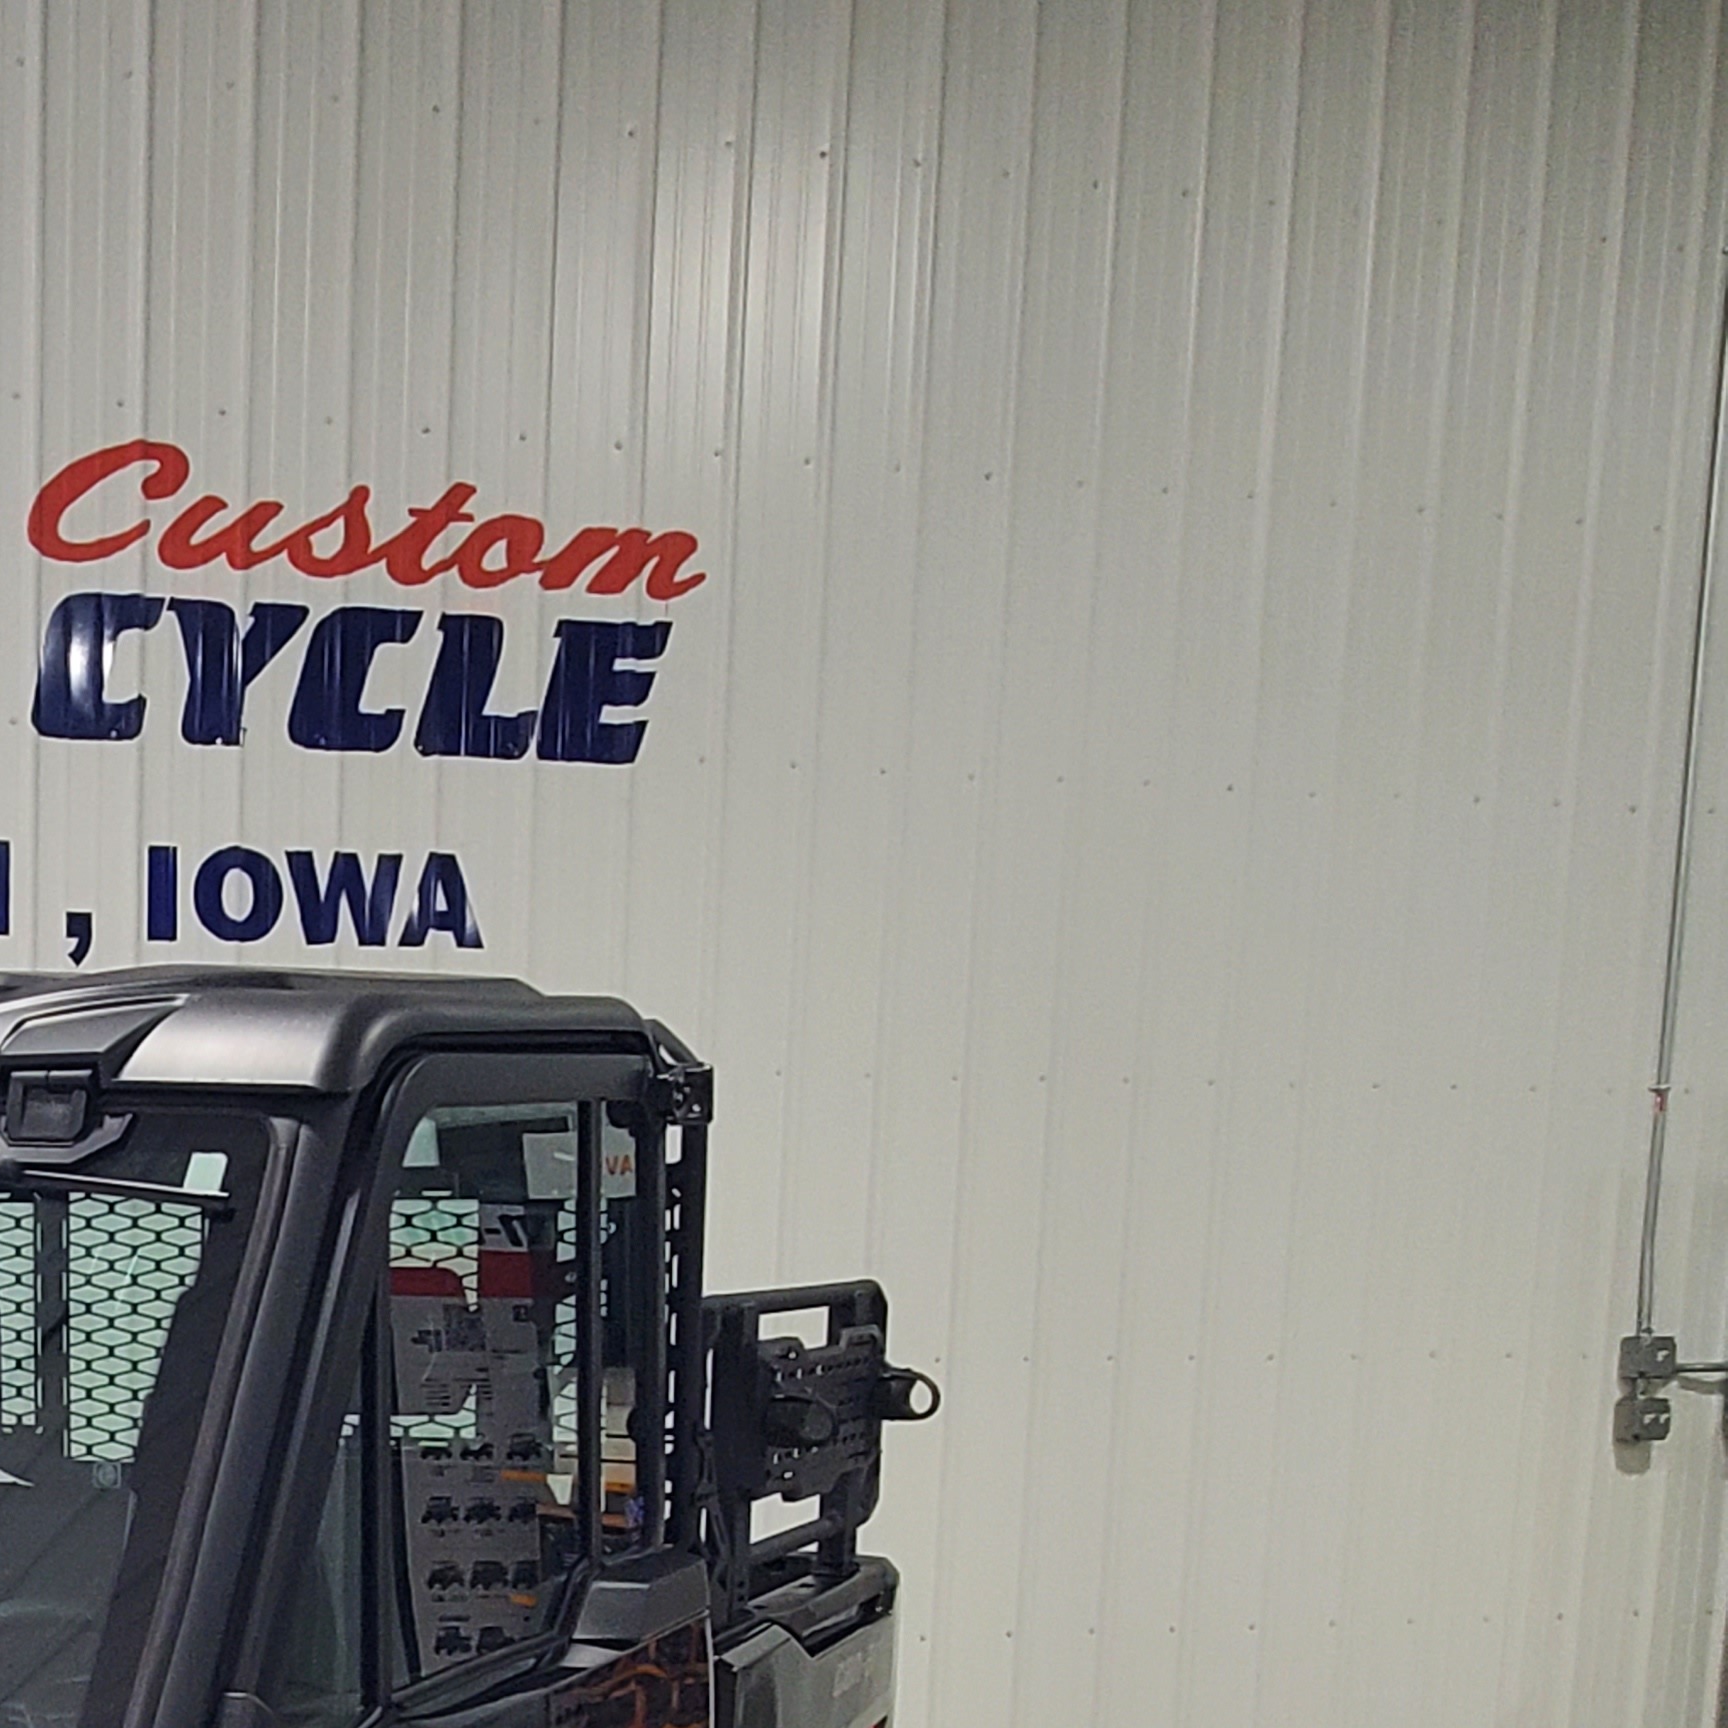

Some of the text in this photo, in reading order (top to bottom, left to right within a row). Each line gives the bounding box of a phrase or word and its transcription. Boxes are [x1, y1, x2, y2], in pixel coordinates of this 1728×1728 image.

[28, 440, 706, 599] Custom
[31, 592, 673, 765] CYCLE
[147, 844, 485, 948] IOWA
